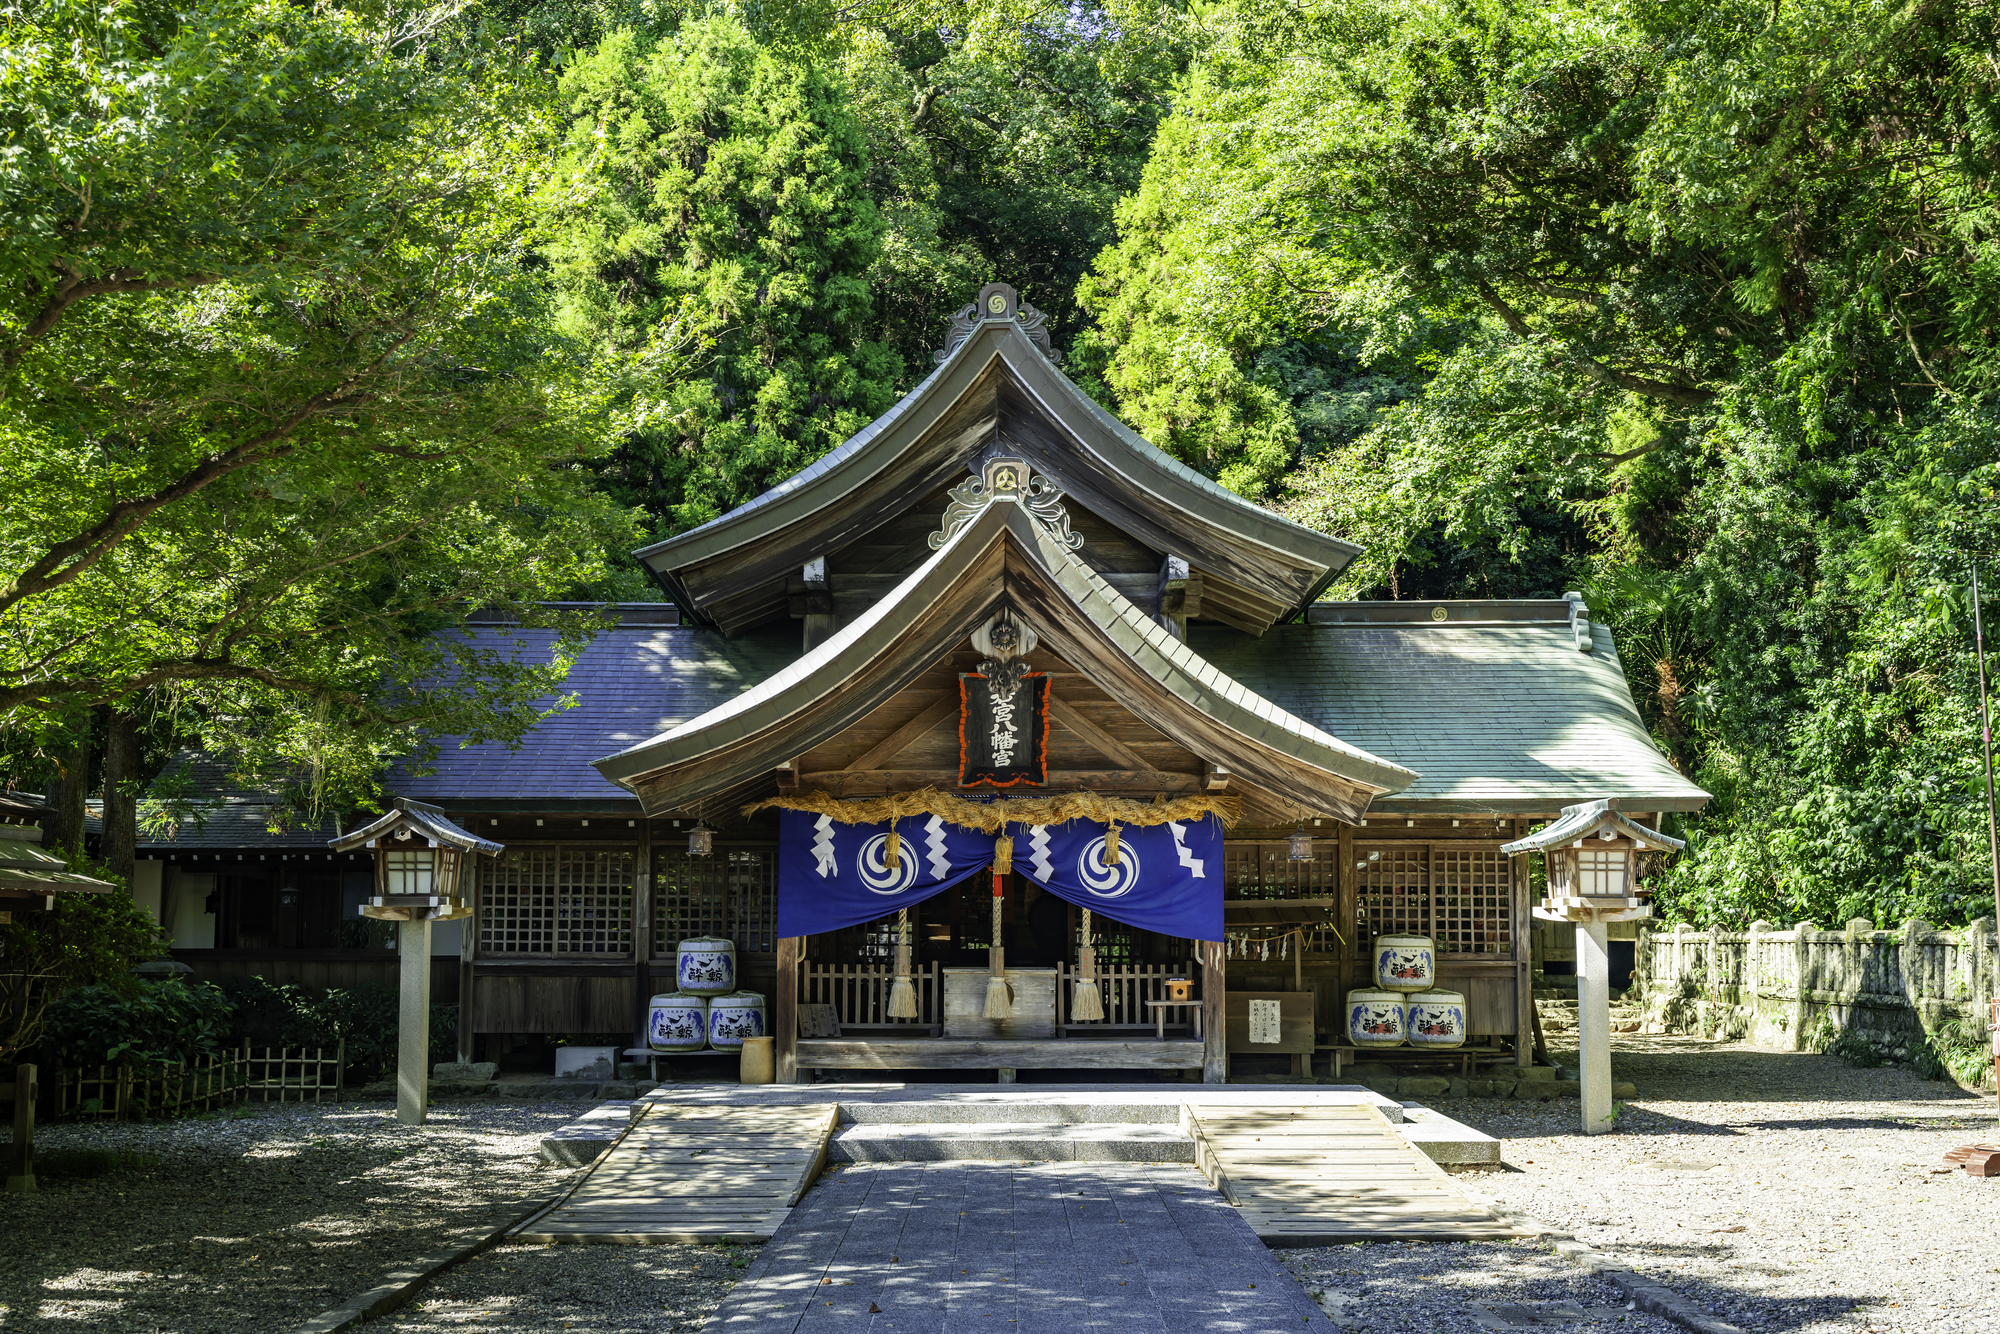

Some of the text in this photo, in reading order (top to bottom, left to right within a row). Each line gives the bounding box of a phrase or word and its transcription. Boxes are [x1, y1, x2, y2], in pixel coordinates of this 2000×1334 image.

[688, 967, 723, 983] 酔鯨
[1391, 963, 1426, 979] 酔鯨
[658, 1023, 693, 1039] 酔鯨
[717, 1023, 753, 1039] 酔鯨
[1362, 1018, 1398, 1035] 酔鯨
[1417, 1018, 1454, 1036] 酔鯨
